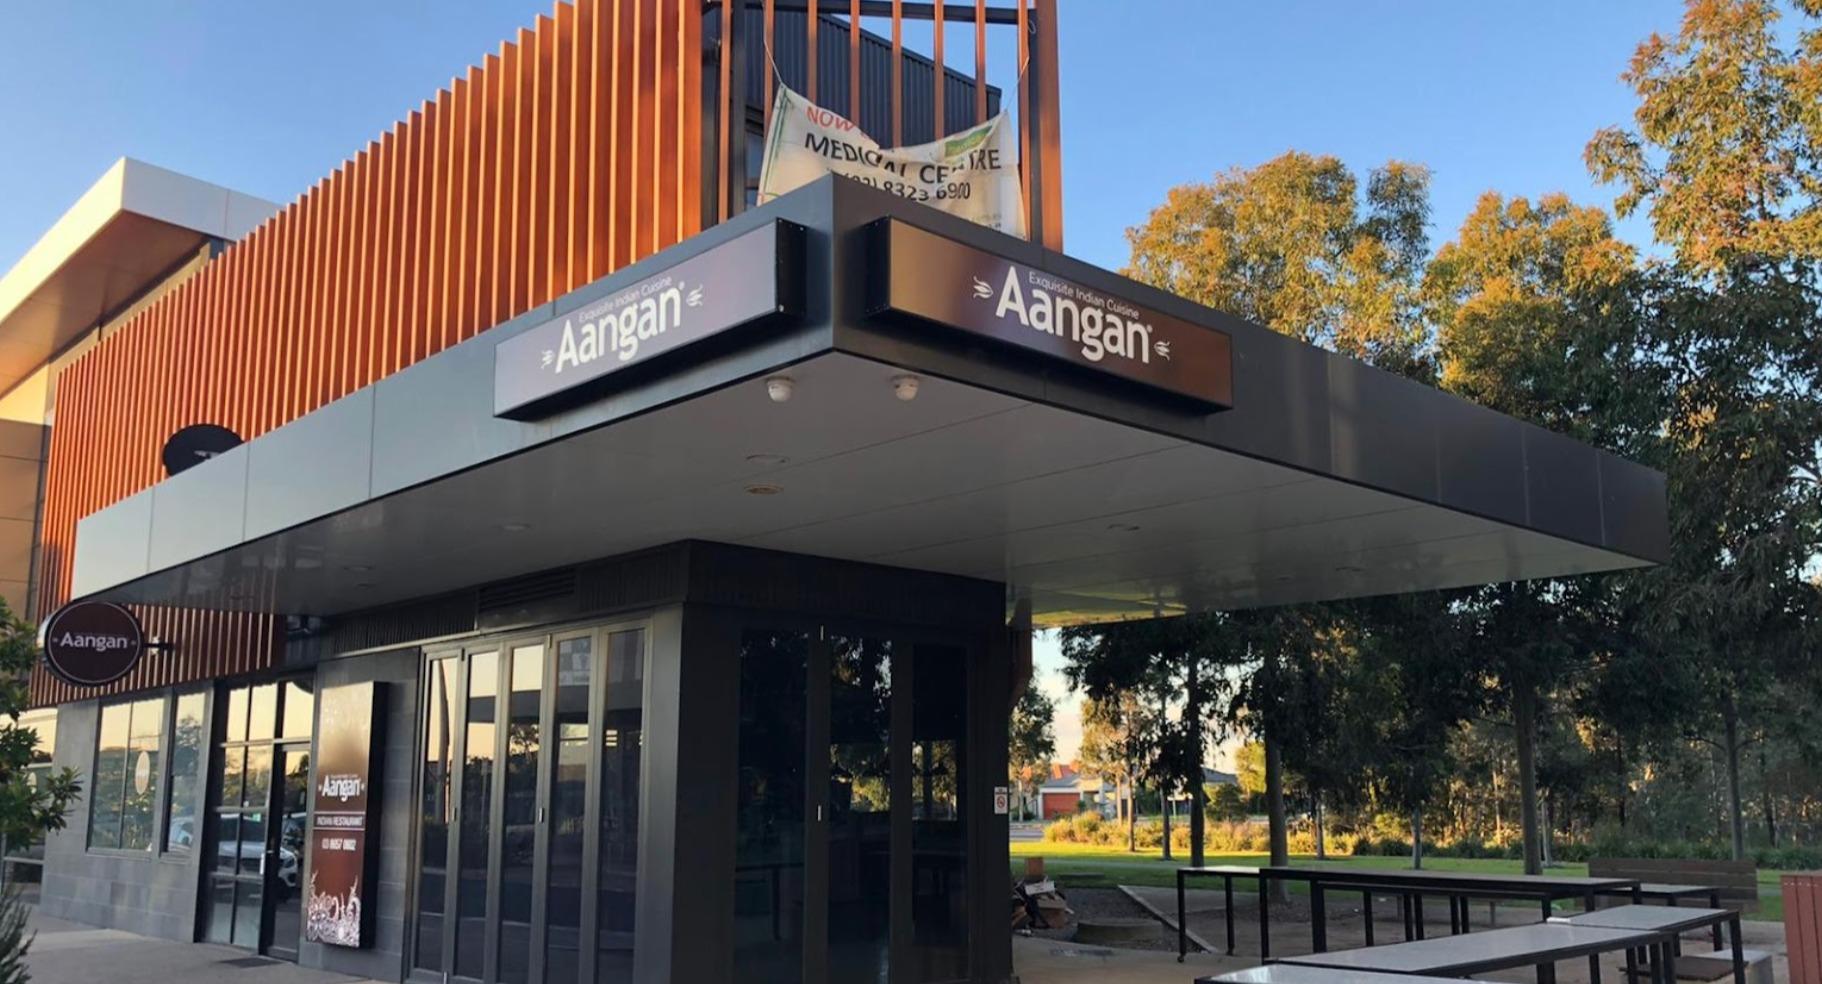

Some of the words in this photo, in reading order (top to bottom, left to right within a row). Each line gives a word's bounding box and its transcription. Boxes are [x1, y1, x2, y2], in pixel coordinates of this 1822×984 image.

[805, 106, 857, 132] NOW
[919, 149, 1002, 184] CETRE
[1029, 271, 1075, 298] Exquisite
[1076, 288, 1105, 308] Indian
[1106, 298, 1139, 319] Cuisine
[554, 287, 681, 374] Aangan
[996, 265, 1150, 364] Aangan
[60, 631, 128, 652] Aangan
[322, 775, 361, 802] Aangan
